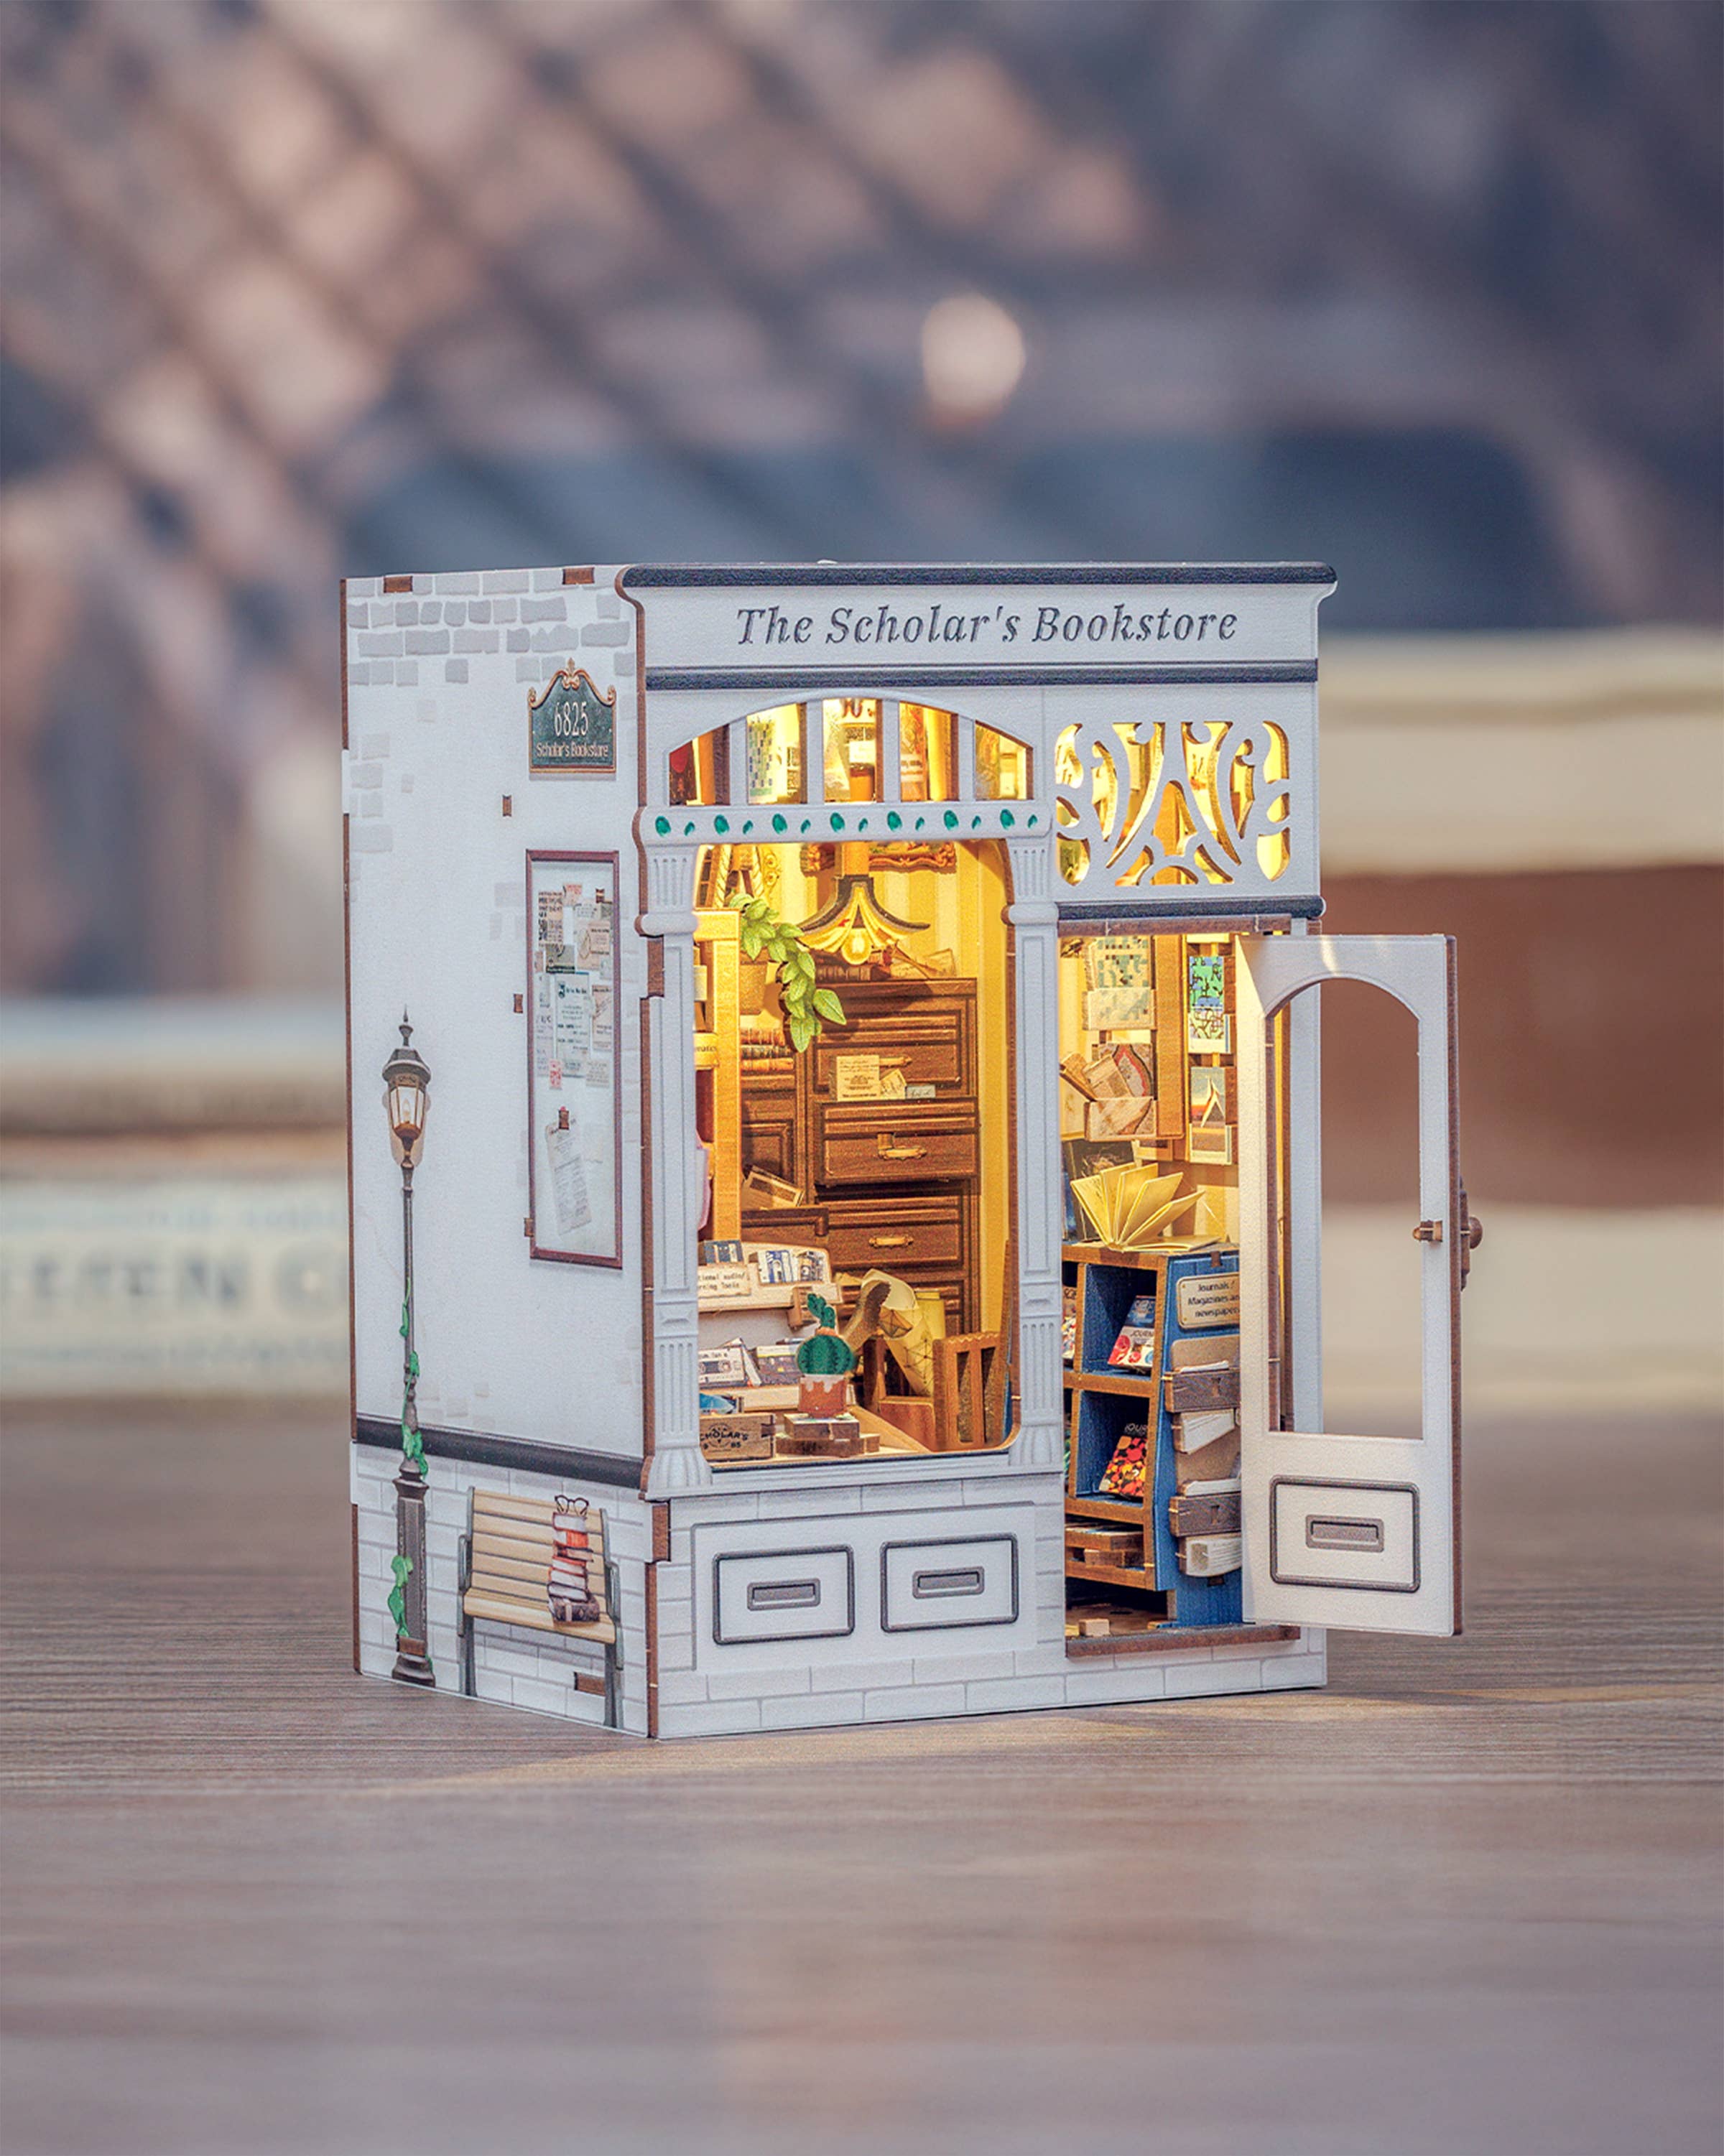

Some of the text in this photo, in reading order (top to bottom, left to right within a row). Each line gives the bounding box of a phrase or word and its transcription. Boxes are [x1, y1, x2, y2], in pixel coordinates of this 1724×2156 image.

[736, 603, 1238, 644] The Scholar's Bookstore
[555, 701, 589, 736] 6825
